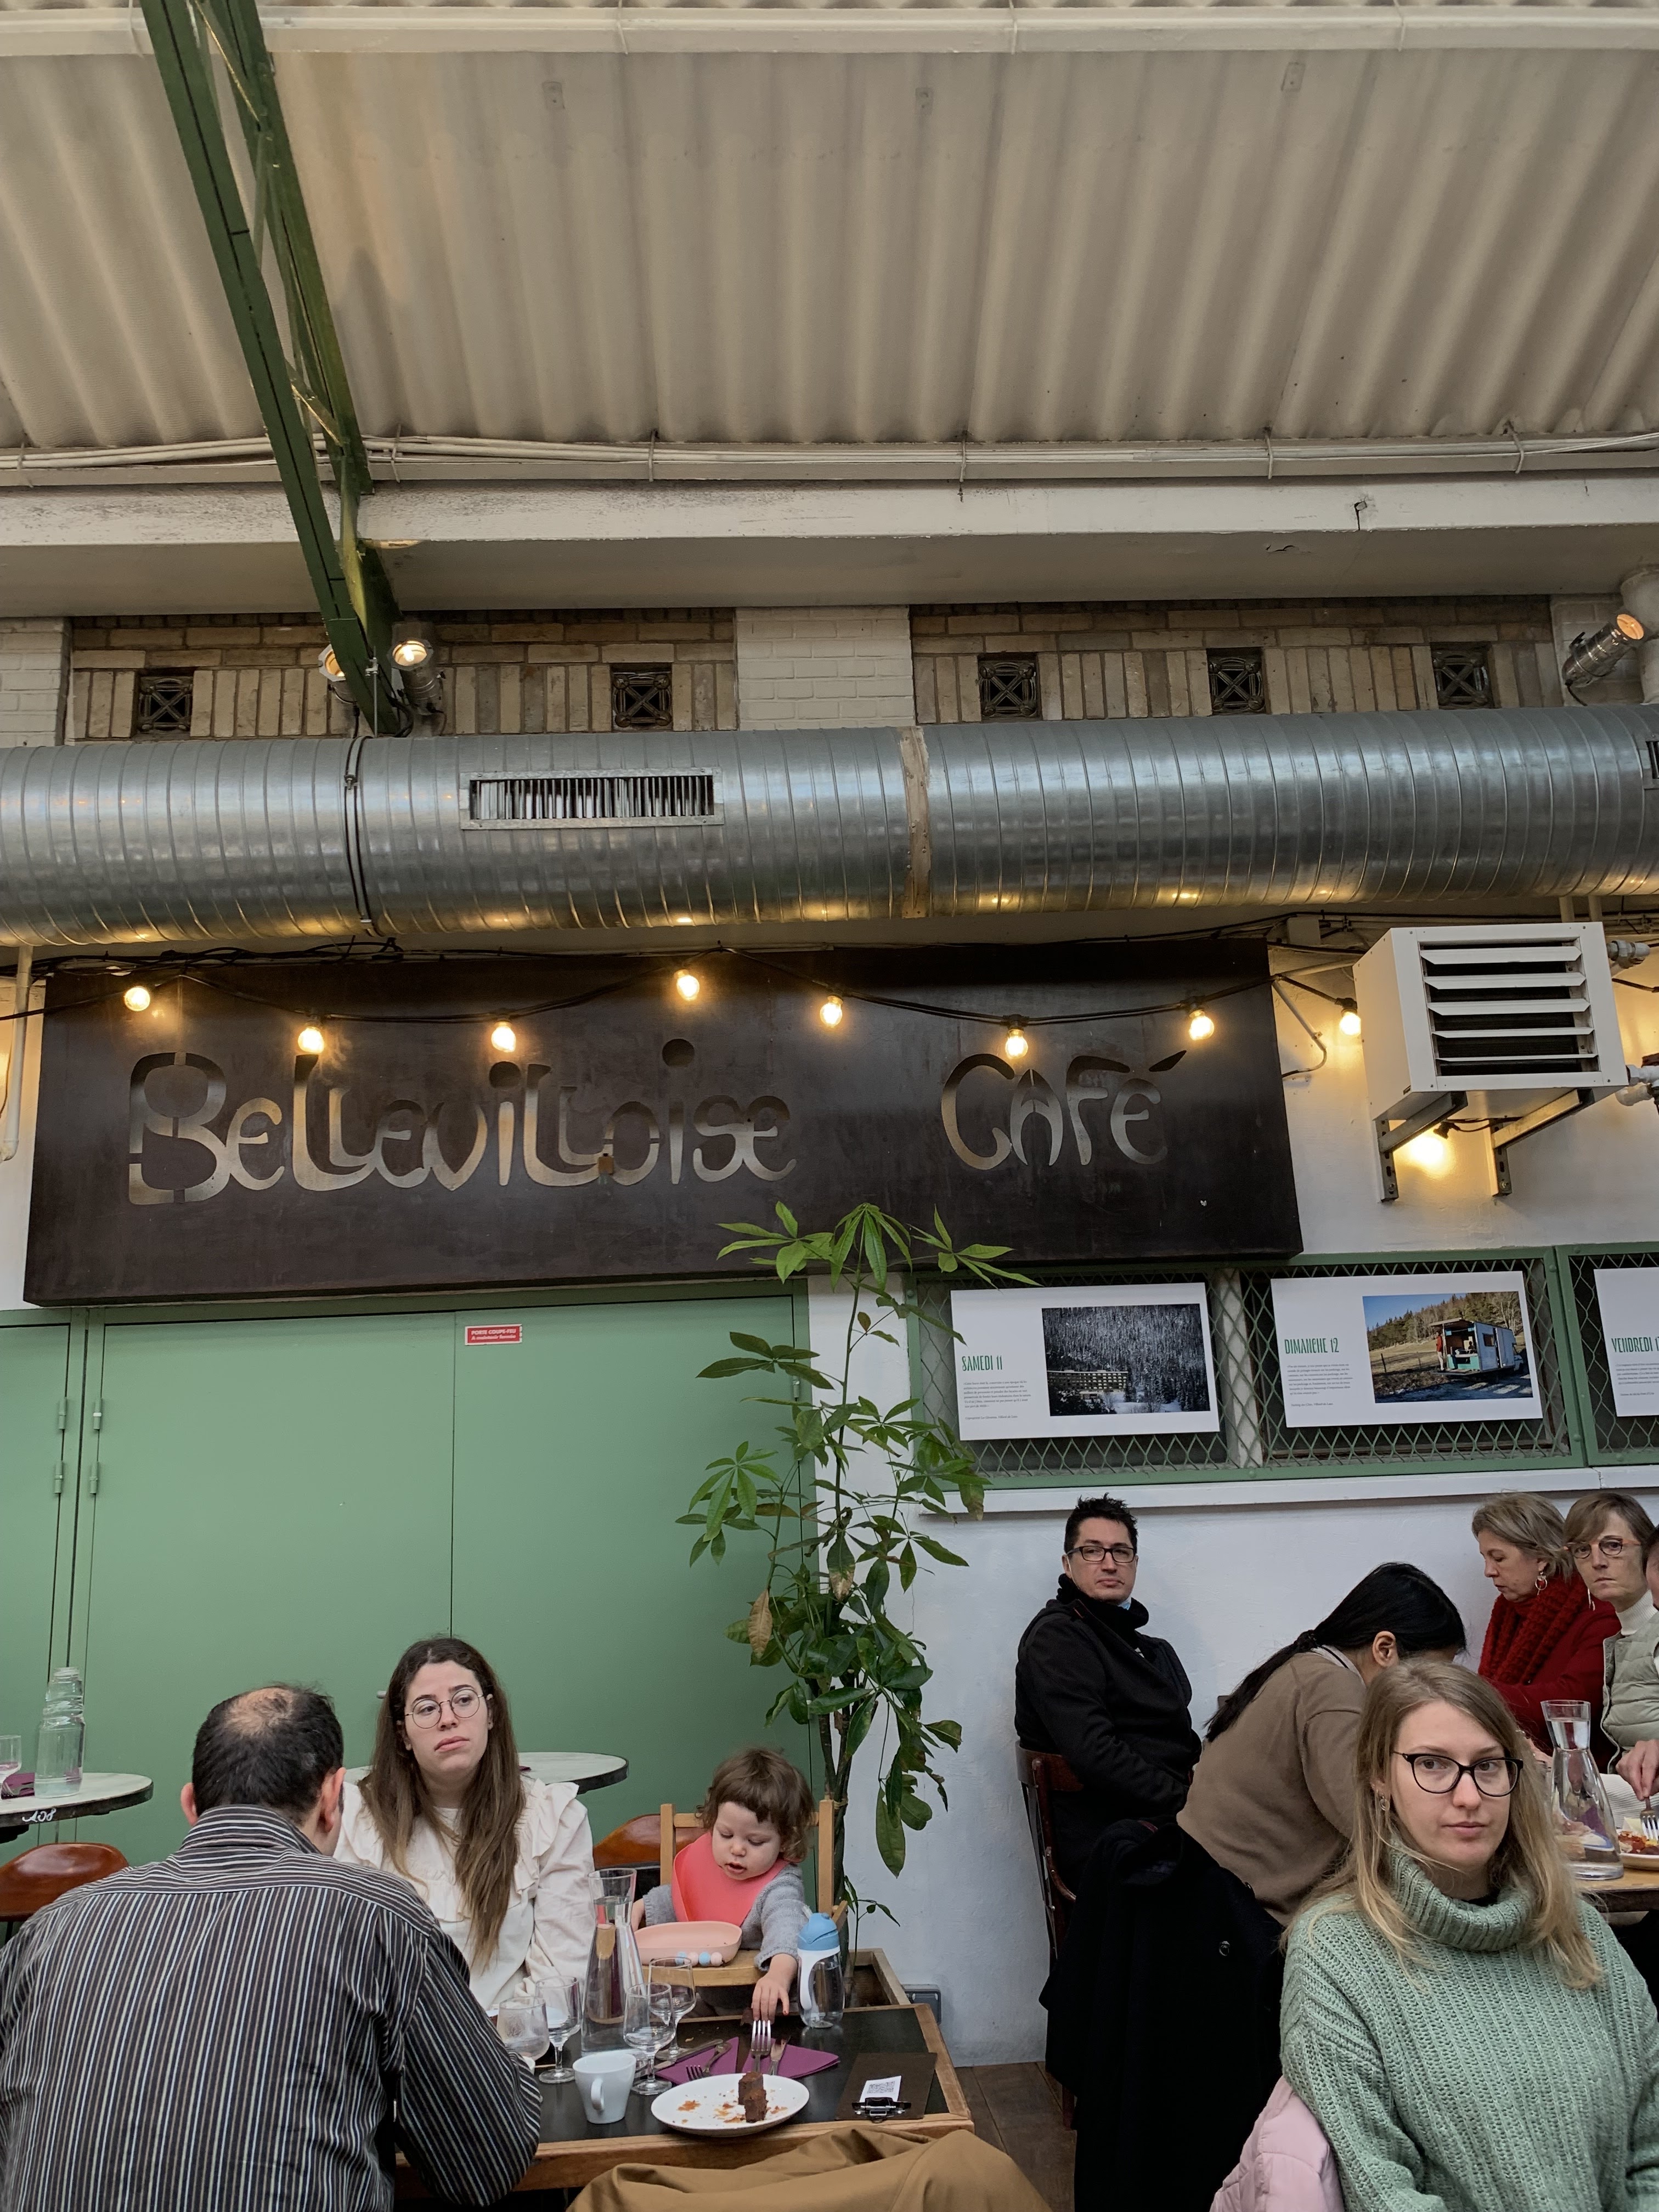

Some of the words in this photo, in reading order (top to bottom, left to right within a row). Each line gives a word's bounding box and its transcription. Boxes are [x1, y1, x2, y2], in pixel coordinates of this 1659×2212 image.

[1284, 1338, 1328, 1354] DIMANCHE
[1330, 1338, 1339, 1353] 12
[1611, 1336, 1653, 1353] VENDREDI
[962, 1355, 993, 1372] SAMEDI
[996, 1355, 1002, 1370] 11
